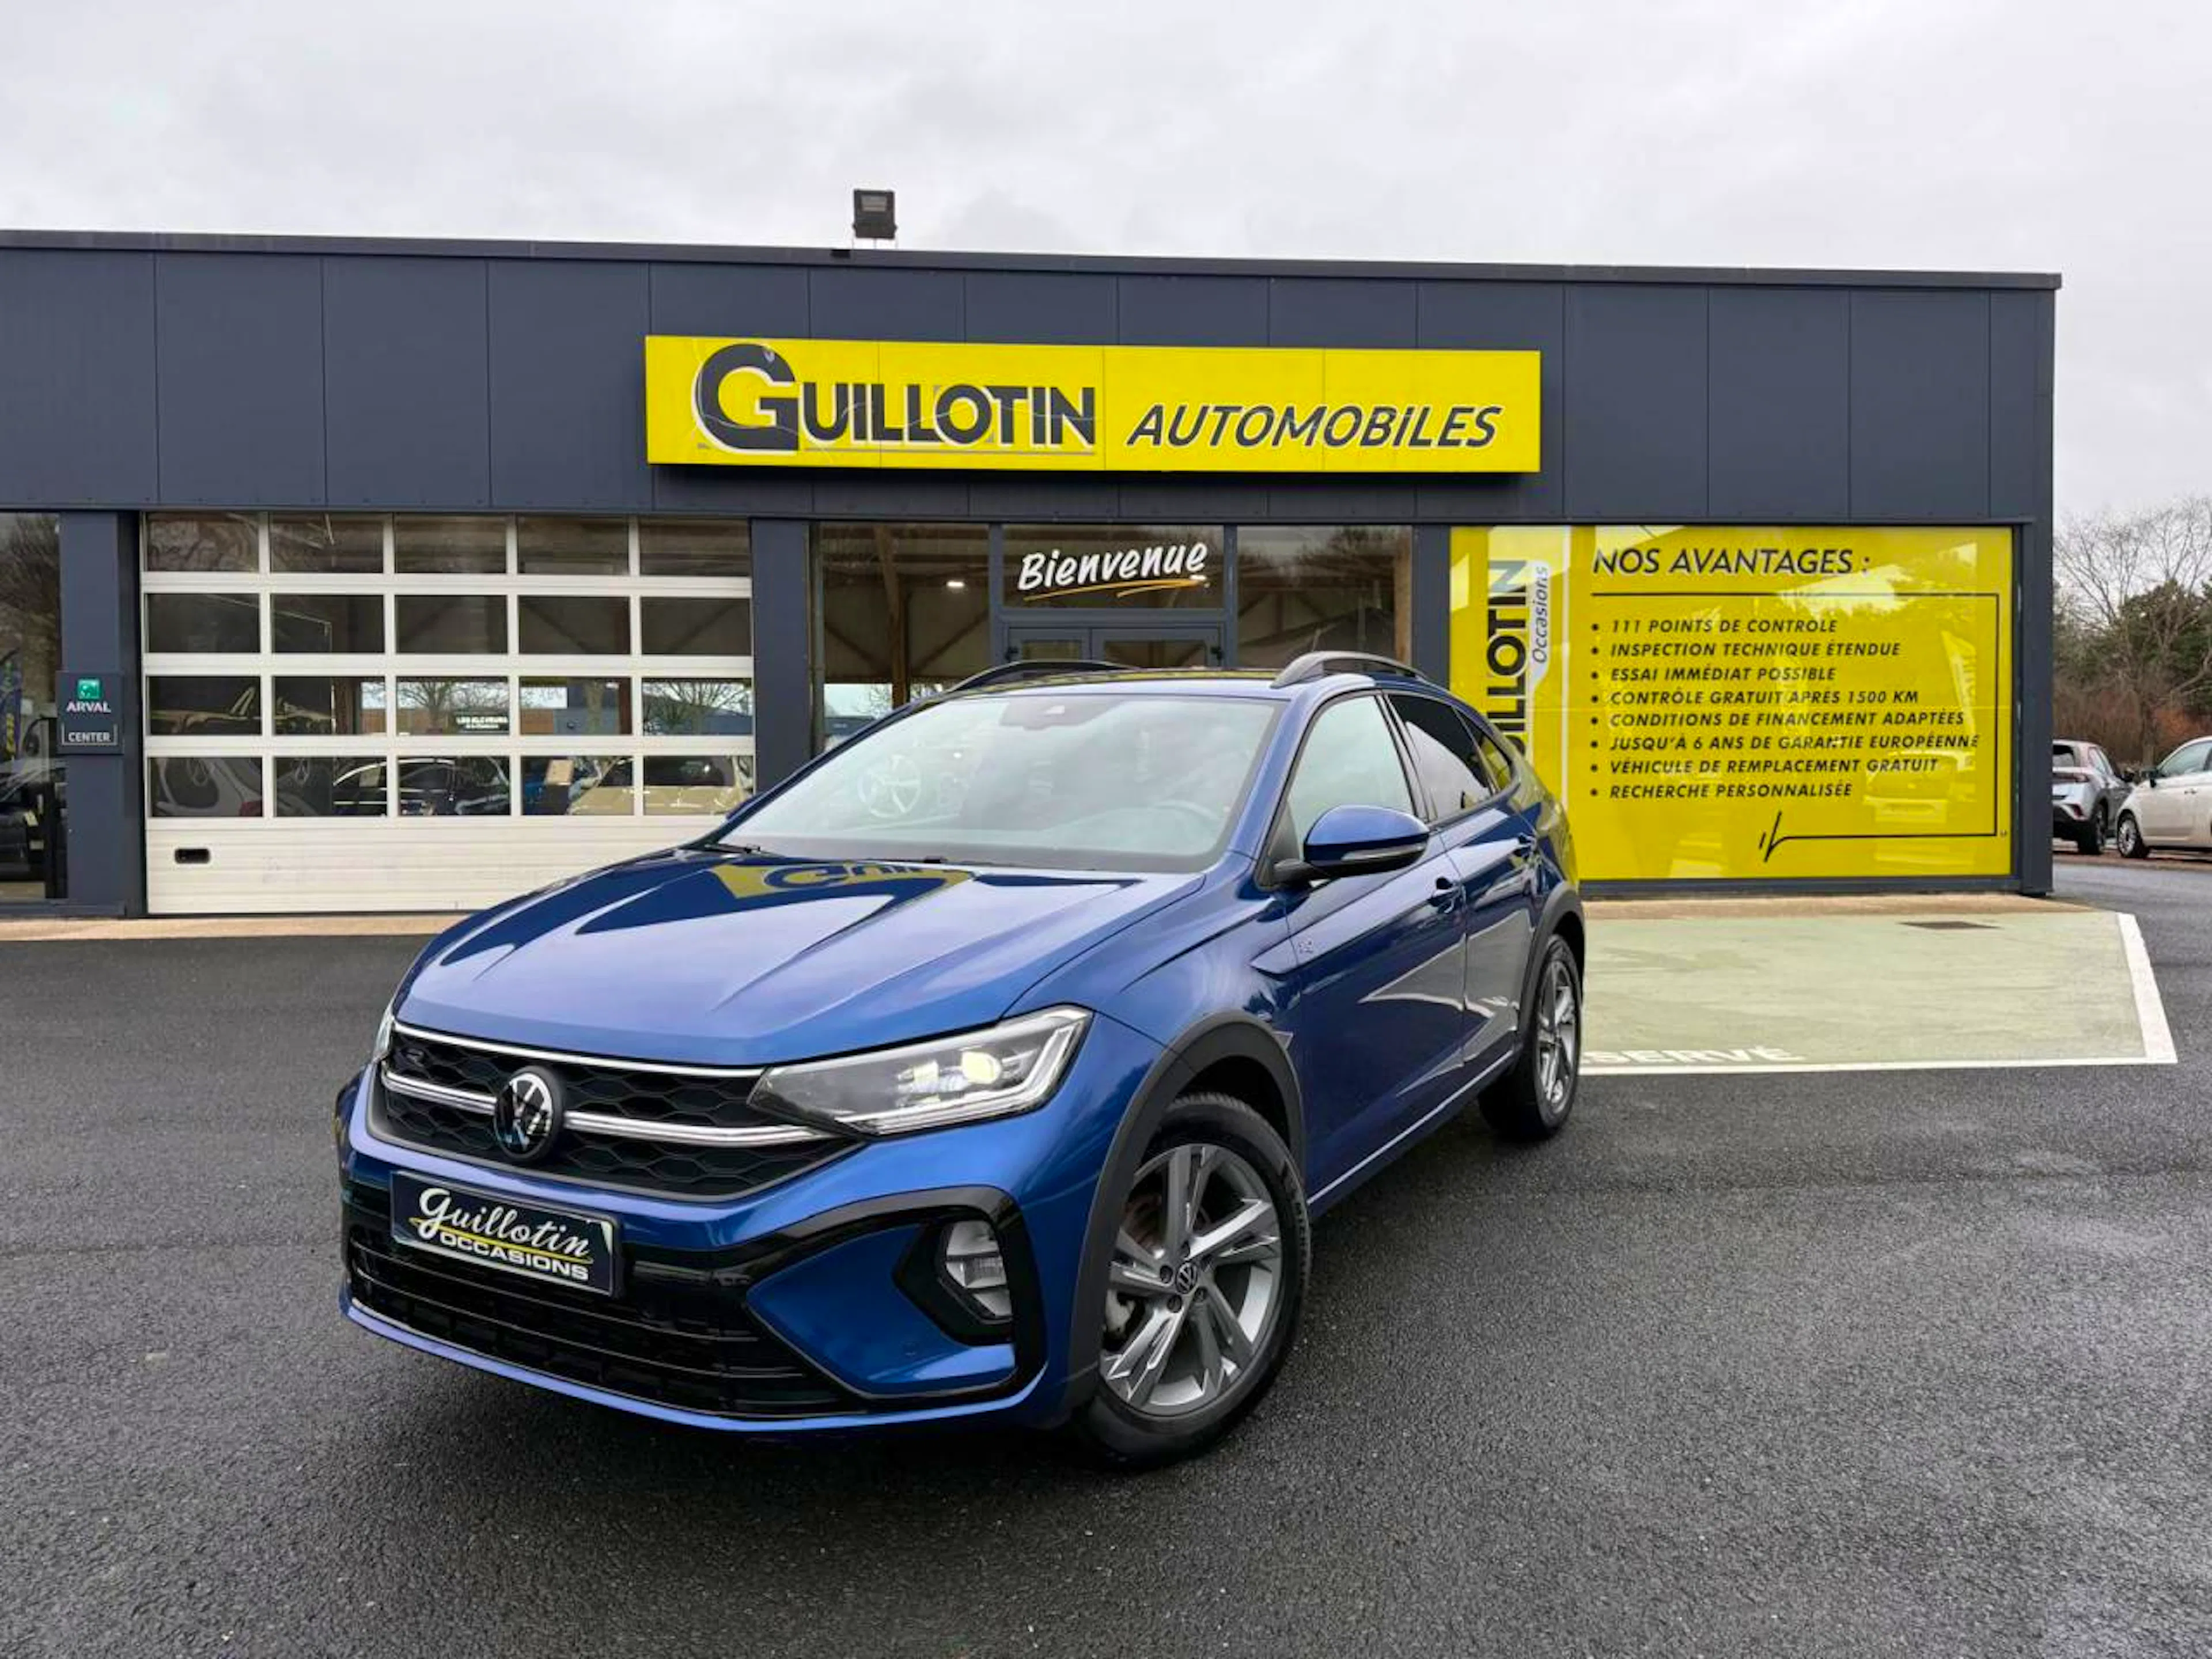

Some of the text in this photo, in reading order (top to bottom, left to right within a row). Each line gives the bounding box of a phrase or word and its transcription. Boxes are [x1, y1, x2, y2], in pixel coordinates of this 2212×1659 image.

[695, 343, 1095, 450] GUILLOTIN
[1018, 542, 1208, 591] Bienvenue
[1593, 548, 1660, 574] NOS
[1668, 548, 1853, 574] AVANTAGES
[1532, 566, 1548, 664] Occasions
[1612, 620, 1641, 633] 111
[1649, 619, 1713, 633] POINTS
[1719, 619, 1741, 632] DE
[1487, 559, 1527, 755] ILLOTIN
[1611, 643, 1715, 657] INSPECTION
[1723, 642, 1822, 657] TECHNIQUE
[1611, 663, 1836, 681] ESSAI IMMÉDIAT POSSIBLE
[1611, 686, 1703, 704] CONTRÔLE
[1710, 691, 1782, 704] GRATUIT
[1847, 691, 1888, 704] 1500
[1892, 691, 1918, 703] KM
[66, 702, 112, 713] ARVAL
[1610, 708, 1965, 727] CONDITIONS DE FINANCEMENT ADAPTÉES
[67, 732, 111, 743] CENTER
[1693, 736, 1703, 749] 6
[1709, 736, 1744, 750] ANS
[1750, 736, 1772, 749] DE
[1778, 736, 1864, 749] GARANTIE
[1610, 756, 1938, 774] VÉHICULE DE REMPLACEMENT GRATUIT
[1609, 780, 1853, 798] RECHERCHE PERSONNALISÉE
[1581, 1044, 1807, 1064] SERVÉ
[440, 1230, 589, 1281] OCCASIONS
